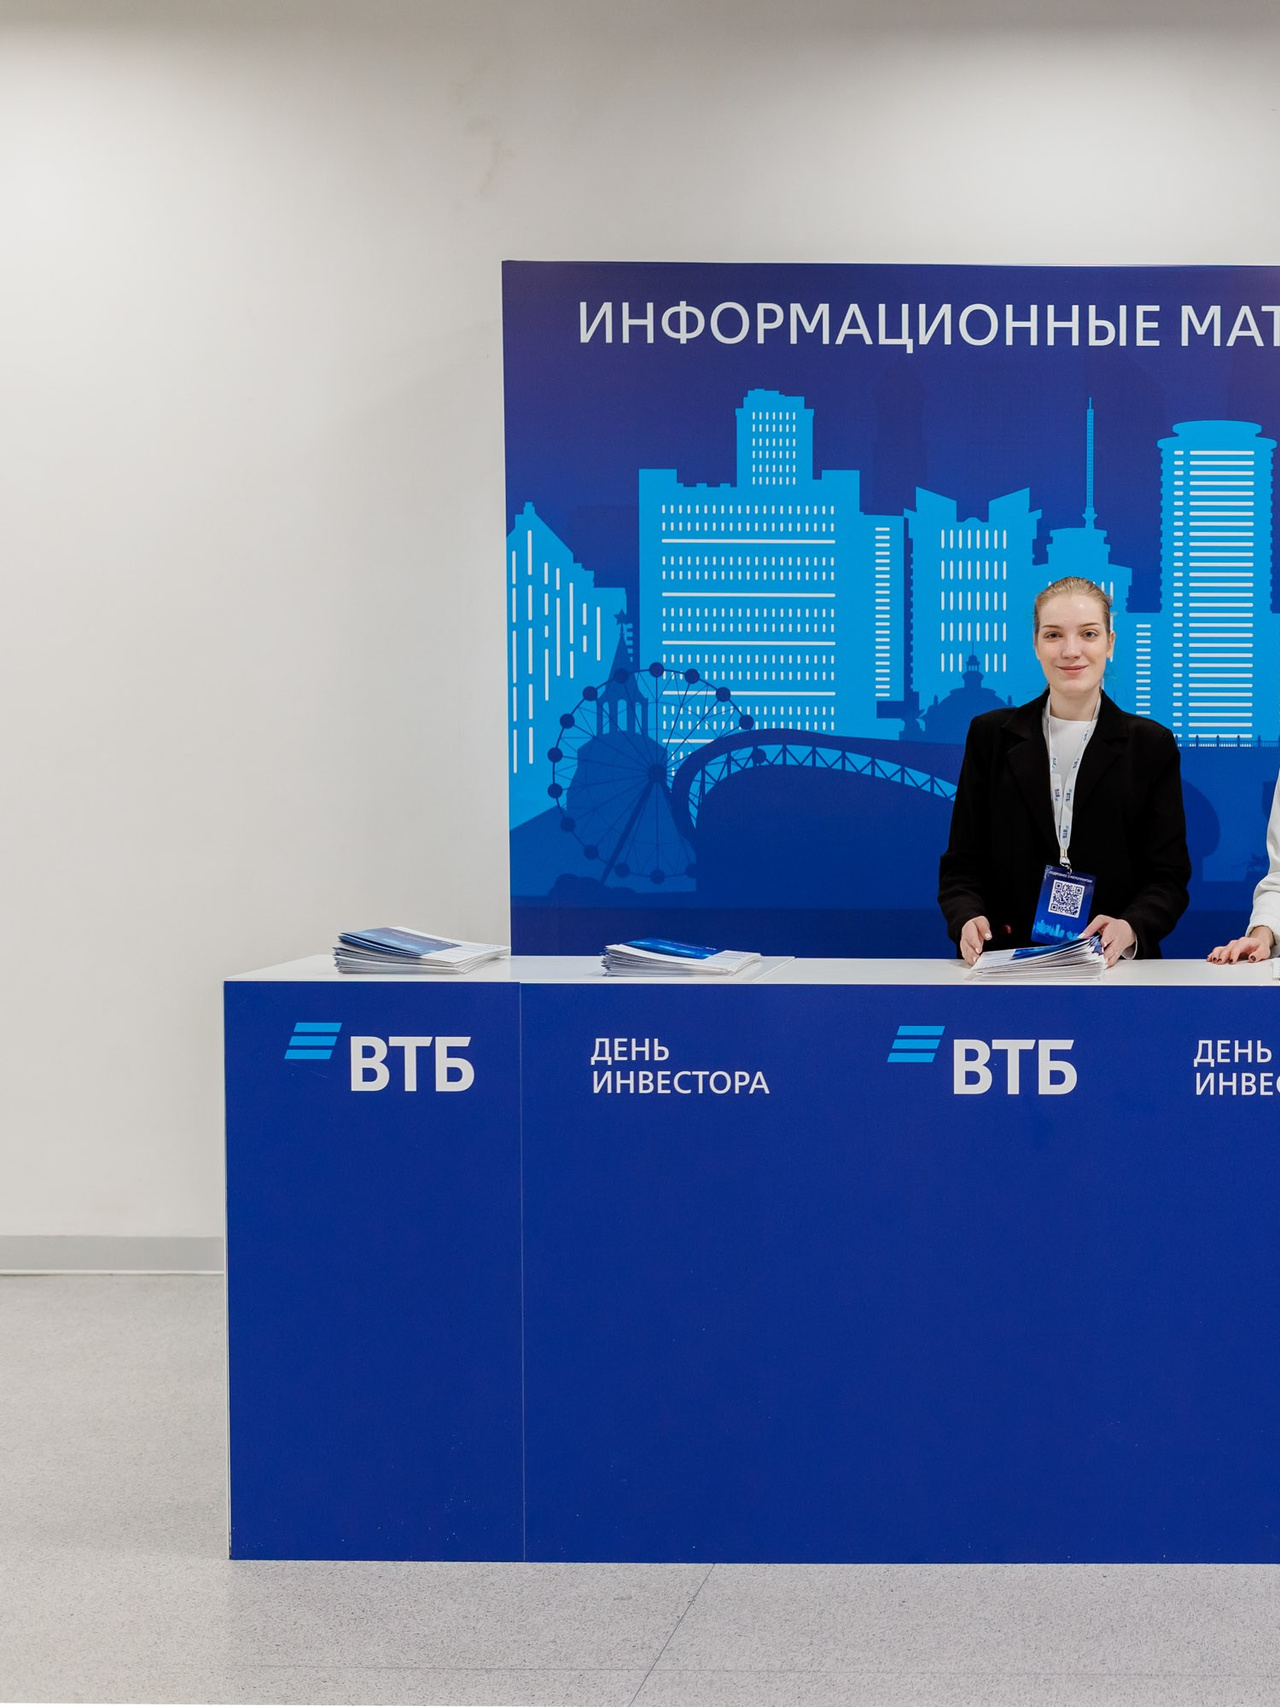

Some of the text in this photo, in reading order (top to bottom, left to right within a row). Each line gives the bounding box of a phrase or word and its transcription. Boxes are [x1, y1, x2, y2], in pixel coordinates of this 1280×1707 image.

[579, 300, 1161, 354] ИНФОРМАЦИОННЫЕ
[350, 1036, 475, 1092] ВТБ
[590, 1037, 670, 1066] ДЕНЬ
[953, 1039, 1078, 1095] ВТБ
[1193, 1039, 1272, 1068] ДЕНЬ
[593, 1070, 770, 1094] ИНВЕСТОРА
